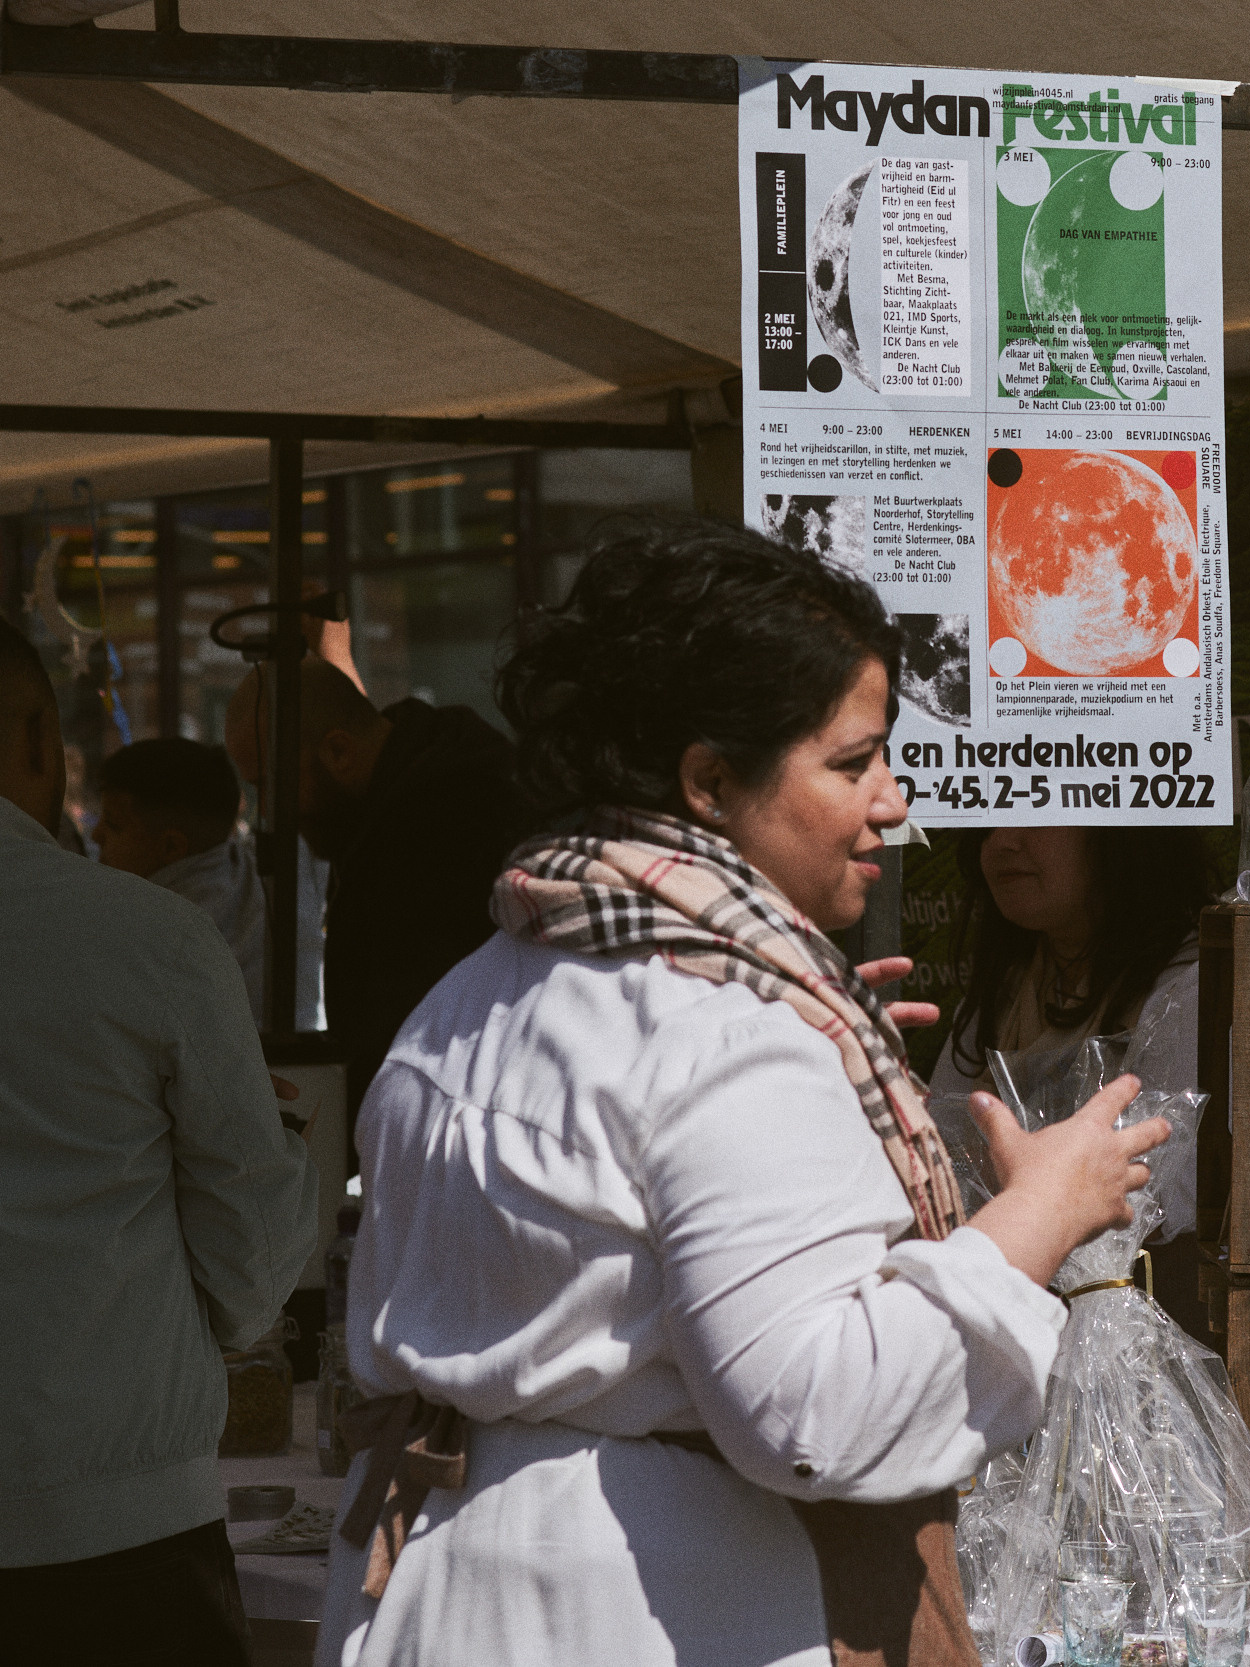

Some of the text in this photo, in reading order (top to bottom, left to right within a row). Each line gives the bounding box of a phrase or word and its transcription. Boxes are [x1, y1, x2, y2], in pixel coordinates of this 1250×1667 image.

[1154, 93, 1214, 107] gratis toegang
[777, 74, 990, 146] Maydan
[1002, 84, 1197, 146] Festival
[881, 157, 892, 167] De
[895, 158, 911, 170] dag
[932, 160, 953, 171] gast-
[1004, 152, 1210, 168] 3 MEI 9:00 23:00
[881, 170, 912, 182] vrijheid
[928, 172, 954, 182] barm-
[881, 183, 956, 196] hartigheid (Eid ul
[882, 196, 900, 206] Fitr)
[934, 198, 955, 208] feest
[775, 169, 786, 254] FAMILIEPLEIN
[902, 210, 920, 221] jong
[936, 211, 951, 220] oud
[882, 221, 948, 234] vol ontmoeting,
[882, 234, 956, 247] spel, koekjesfeest
[1060, 228, 1158, 241] DAG VAN EMPATHIE
[895, 247, 931, 258] culturele
[934, 249, 967, 259] (kinder)
[883, 260, 932, 270] activiteiten.
[897, 273, 948, 285] Met Besma,
[883, 285, 950, 297] Stichting Zicht-
[883, 298, 957, 310] baar, Maakplaats
[764, 312, 794, 324] 2 MEI
[883, 310, 960, 323] 021, IMD Sports,
[764, 326, 792, 336] 13:00
[883, 323, 948, 335] Kleintje Kunst,
[765, 338, 792, 349] 17:00
[883, 336, 901, 346] ICK
[905, 337, 926, 347] Dans
[942, 338, 958, 348] vele
[882, 349, 919, 360] anderen.
[1018, 399, 1165, 411] De Nacht Club (23:00 tot 01:00)
[759, 423, 969, 437] 4 MEI 9:00 23:00 HERDENKEN
[993, 428, 1210, 441] 5 MEI 14:00 23:00 BEVRIJDINGSDAG
[760, 441, 967, 456] Rond het vrijheidscarillon, in stilte, met muziek,
[760, 455, 768, 464] in
[771, 455, 805, 467] lezingen
[822, 456, 839, 466] met
[842, 456, 889, 468] storytelling
[893, 458, 936, 468] herdenken
[1201, 447, 1210, 488] SQUARE
[1212, 443, 1220, 493] FREEDOM
[760, 468, 825, 480] geschiedenissen
[847, 469, 873, 479] verzet
[889, 470, 922, 480] conflict.
[873, 495, 962, 507] Met Buurtwerkplaats
[873, 508, 973, 521] Noorderhof, Storytelling
[873, 520, 962, 533] Centre, Herdenkings-
[873, 534, 975, 545] comité Slotermeer, OBA
[1212, 520, 1221, 554] Square.
[894, 559, 955, 570] De Nacht Club
[872, 572, 951, 582] (23:00 tot 01:00)
[1213, 558, 1221, 597] Freedom
[1202, 589, 1212, 621] Orkest,
[1202, 625, 1212, 679] Andalusisch
[1214, 641, 1223, 664] Anas
[995, 680, 1007, 692] Op
[1010, 681, 1024, 690] het
[1028, 681, 1050, 690] Plein
[1054, 681, 1078, 690] vieren
[1096, 681, 1127, 692] vrijheid
[1130, 681, 1147, 690] met
[996, 693, 1077, 704] lampionnenparade,
[1081, 694, 1142, 704] muziekpodium
[1159, 694, 1173, 703] het
[996, 706, 1114, 718] gezamenlijke vrijheidsmaal.
[1203, 683, 1212, 742] Amsterdams
[902, 742, 942, 768] en
[955, 734, 1138, 768] herdenken
[1150, 742, 1192, 775] op
[1060, 776, 1120, 808] mei
[1130, 775, 1214, 808] 2022
